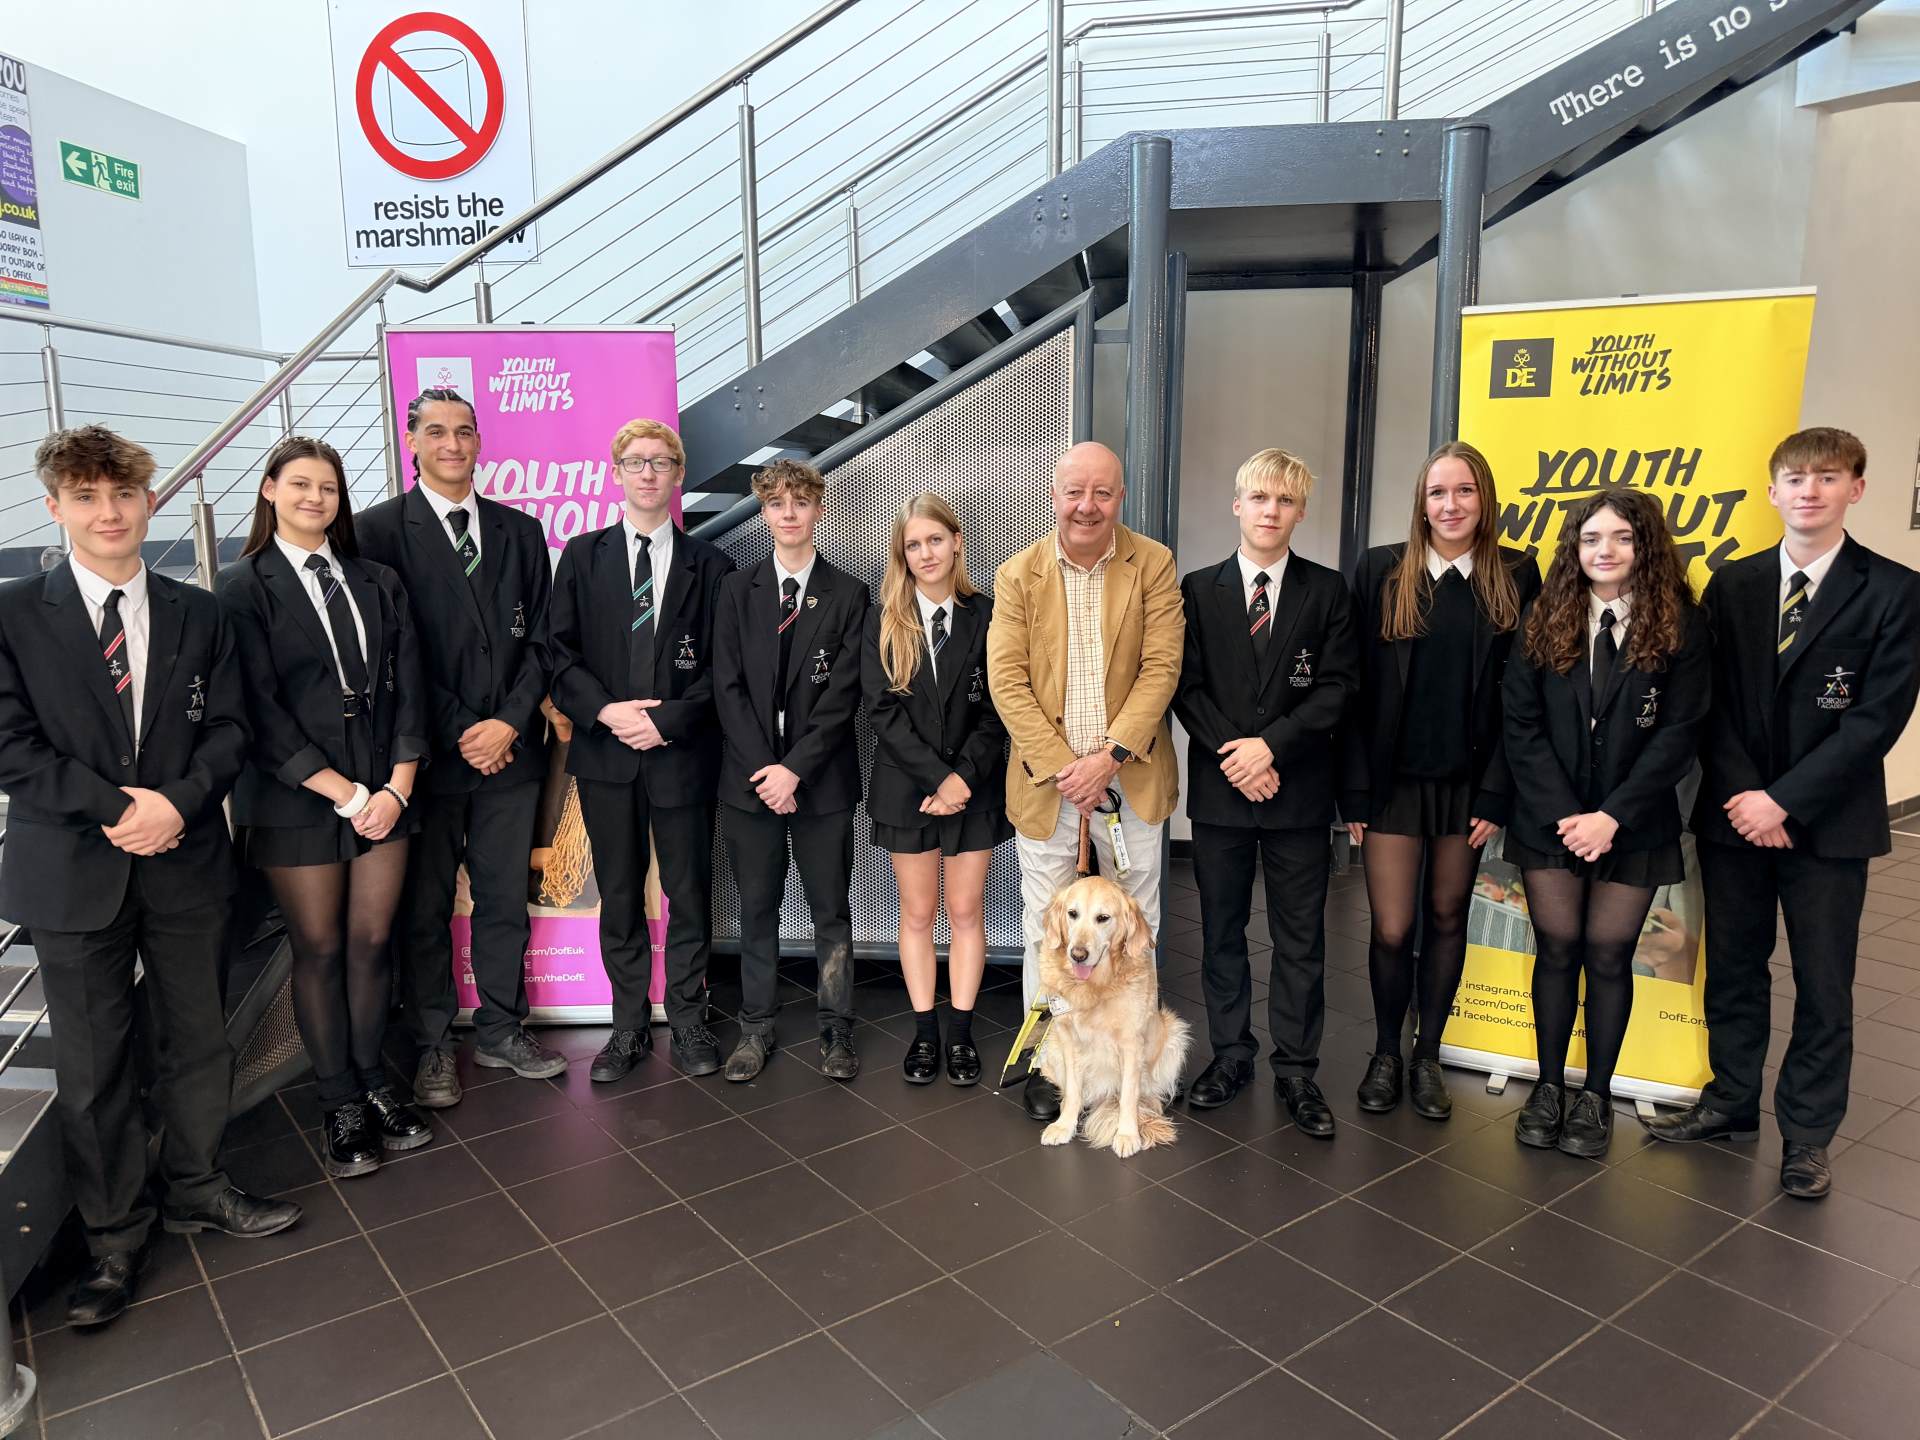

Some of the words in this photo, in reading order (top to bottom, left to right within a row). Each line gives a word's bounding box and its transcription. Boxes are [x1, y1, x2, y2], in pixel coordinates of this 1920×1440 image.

[1549, 64, 1645, 126] There
[1658, 33, 1698, 70] is
[1708, 6, 1752, 42] no
[114, 163, 134, 179] Fire
[116, 179, 135, 194] exit
[374, 194, 449, 221] resist
[458, 192, 504, 218] the
[8, 232, 28, 244] LEAVE
[8, 256, 36, 271] OUTSIDE
[13, 270, 33, 281] OFFICE
[1584, 333, 1657, 355] YOUTH
[499, 357, 556, 375] YOUTH
[1571, 349, 1672, 375] WITHOUT
[488, 372, 571, 393] WITHOUT
[1579, 367, 1672, 397] LIMITS
[498, 389, 575, 413] LIMITS
[473, 459, 607, 500] YOUTH
[1520, 447, 1702, 497] YOUTH
[1496, 489, 1747, 543] WITUT
[524, 946, 585, 957] com/DofEuk
[1465, 981, 1533, 999] instagram.co
[1465, 997, 1527, 1013] x.com/DofE
